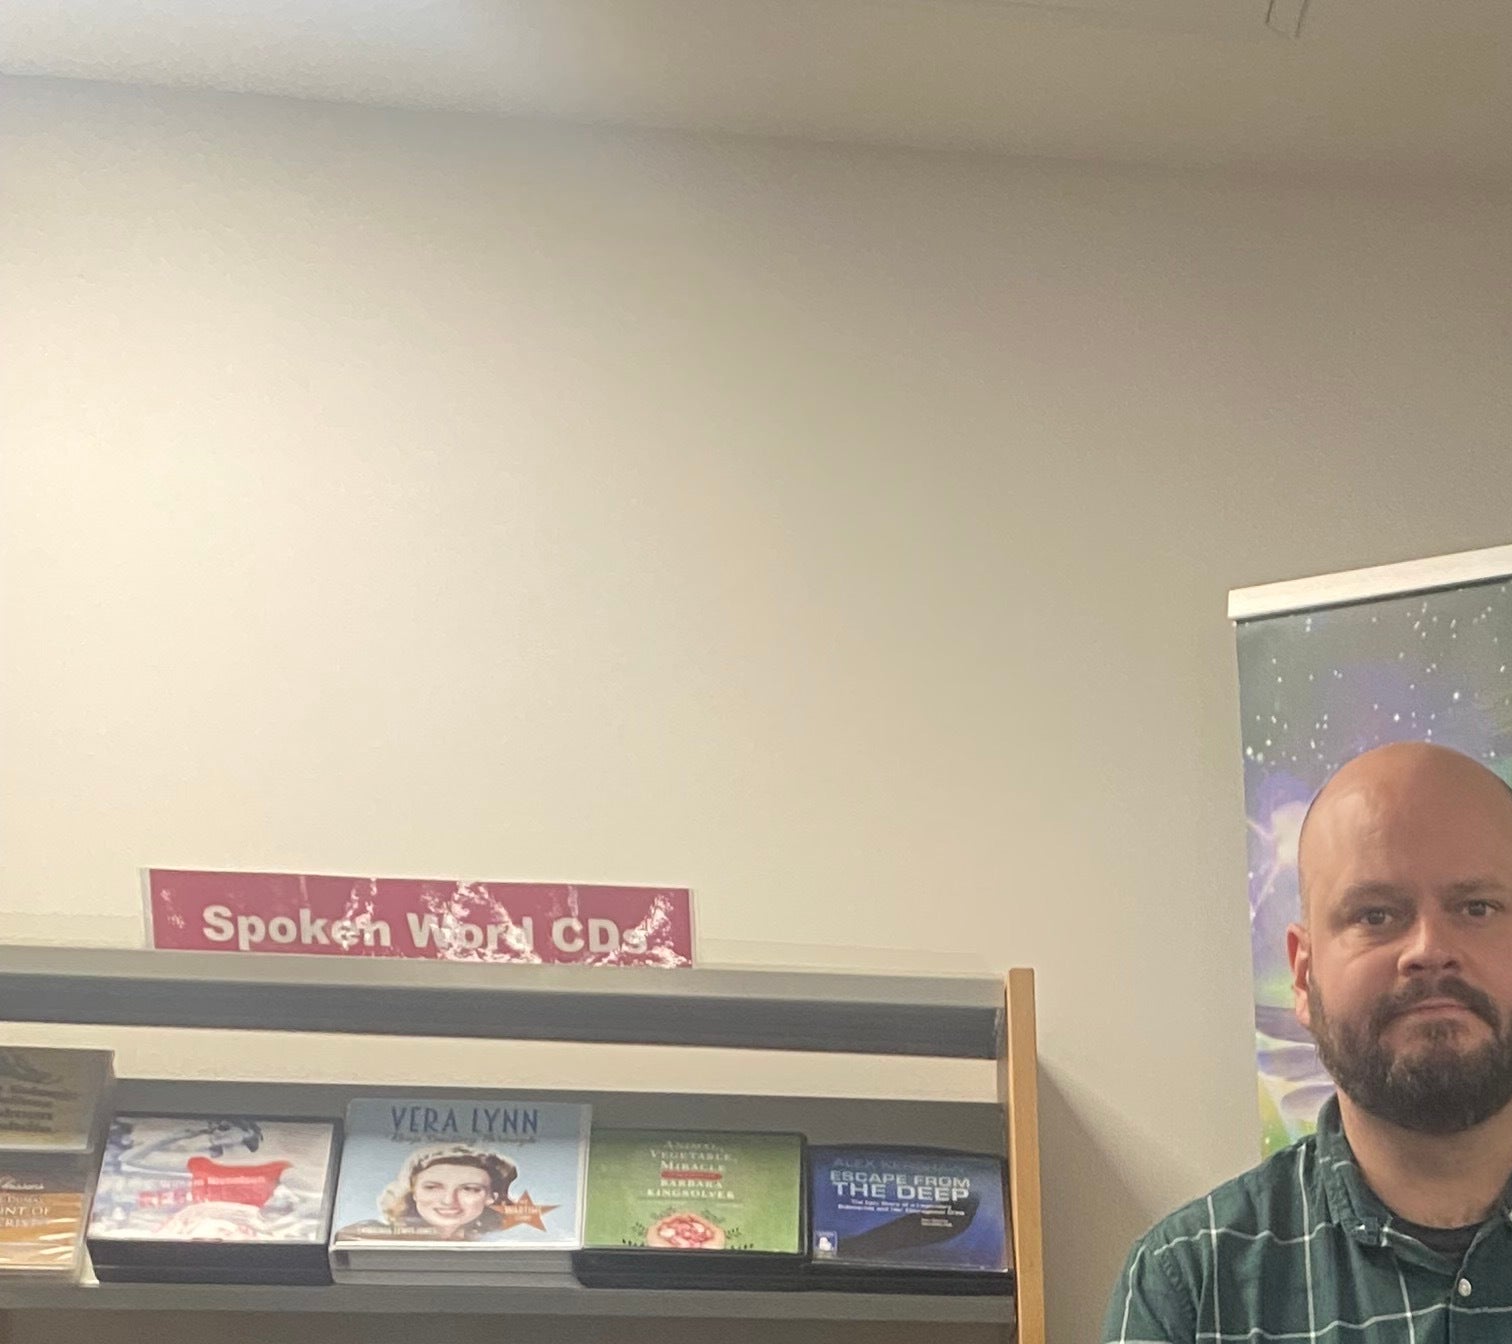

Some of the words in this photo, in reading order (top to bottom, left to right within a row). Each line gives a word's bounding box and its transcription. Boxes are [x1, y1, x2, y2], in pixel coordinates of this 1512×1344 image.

[202, 904, 392, 950] Spoken
[405, 911, 534, 950] Word
[551, 916, 649, 955] CDs
[390, 1105, 458, 1133] VERA
[471, 1107, 539, 1135] LYNN
[660, 1159, 726, 1172] MIRACLE
[660, 1179, 723, 1189] BARBARA
[829, 1169, 908, 1185] ESCAPE
[913, 1174, 971, 1189] FROM
[646, 1188, 735, 1200] KINGSOLVER
[833, 1181, 887, 1199] THE
[896, 1185, 971, 1202] DEEP
